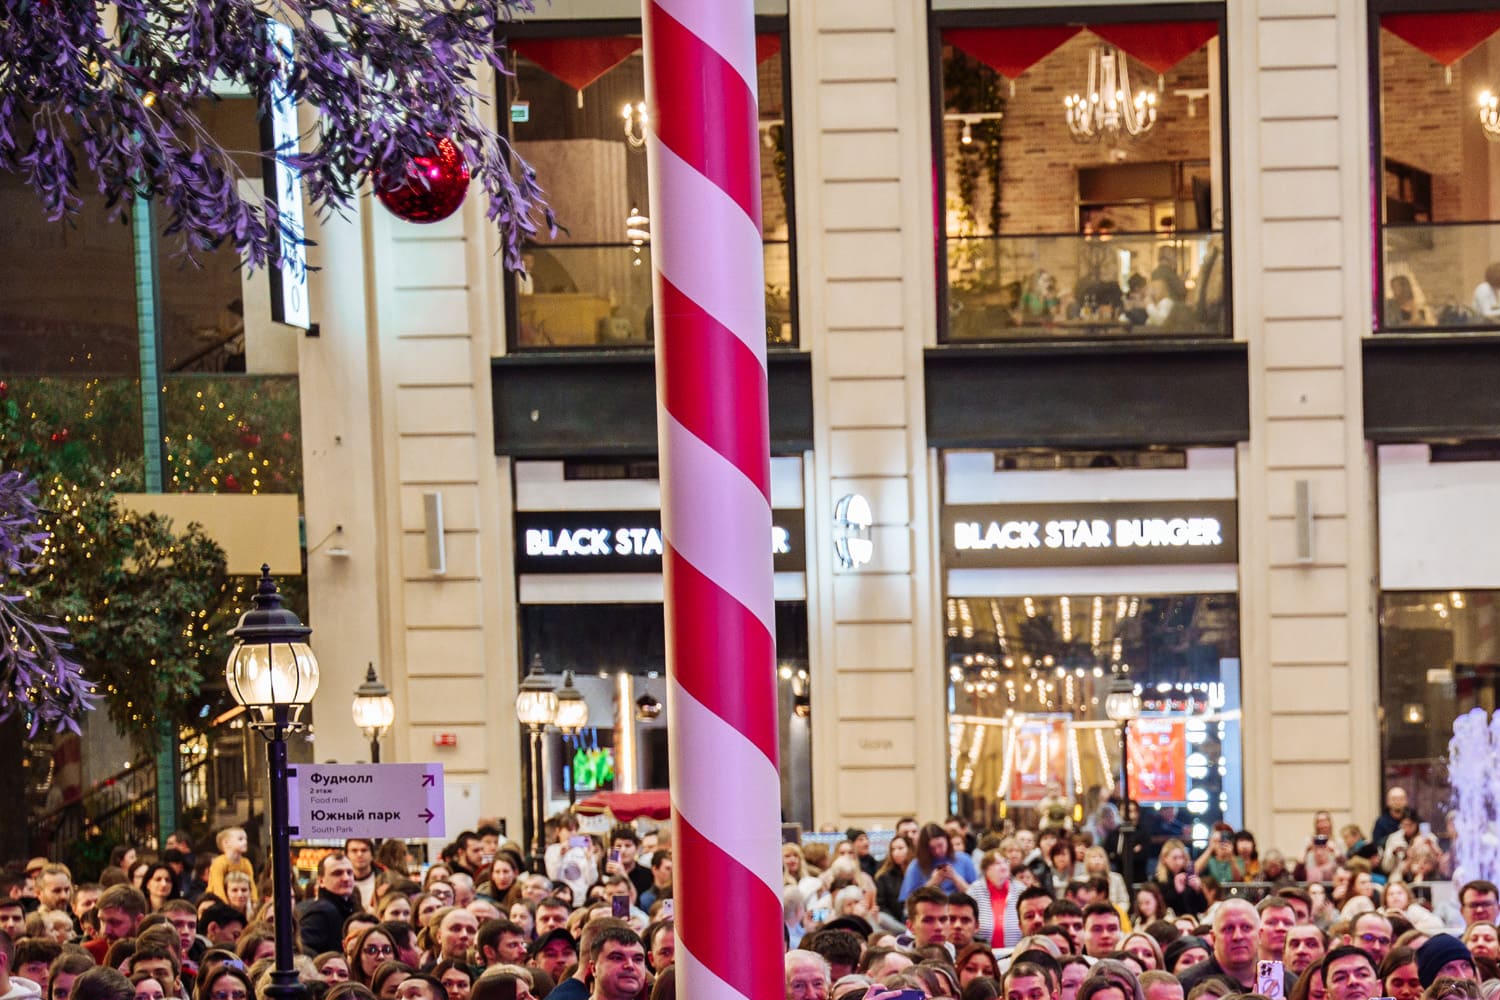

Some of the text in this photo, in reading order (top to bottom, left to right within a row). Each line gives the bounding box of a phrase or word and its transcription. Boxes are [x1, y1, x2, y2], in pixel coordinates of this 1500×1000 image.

[526, 527, 662, 556] BLACK STA
[954, 517, 1222, 549] BLACK STAR BURGER
[310, 772, 373, 785] Фудмолл
[310, 810, 401, 823] Южный парк
